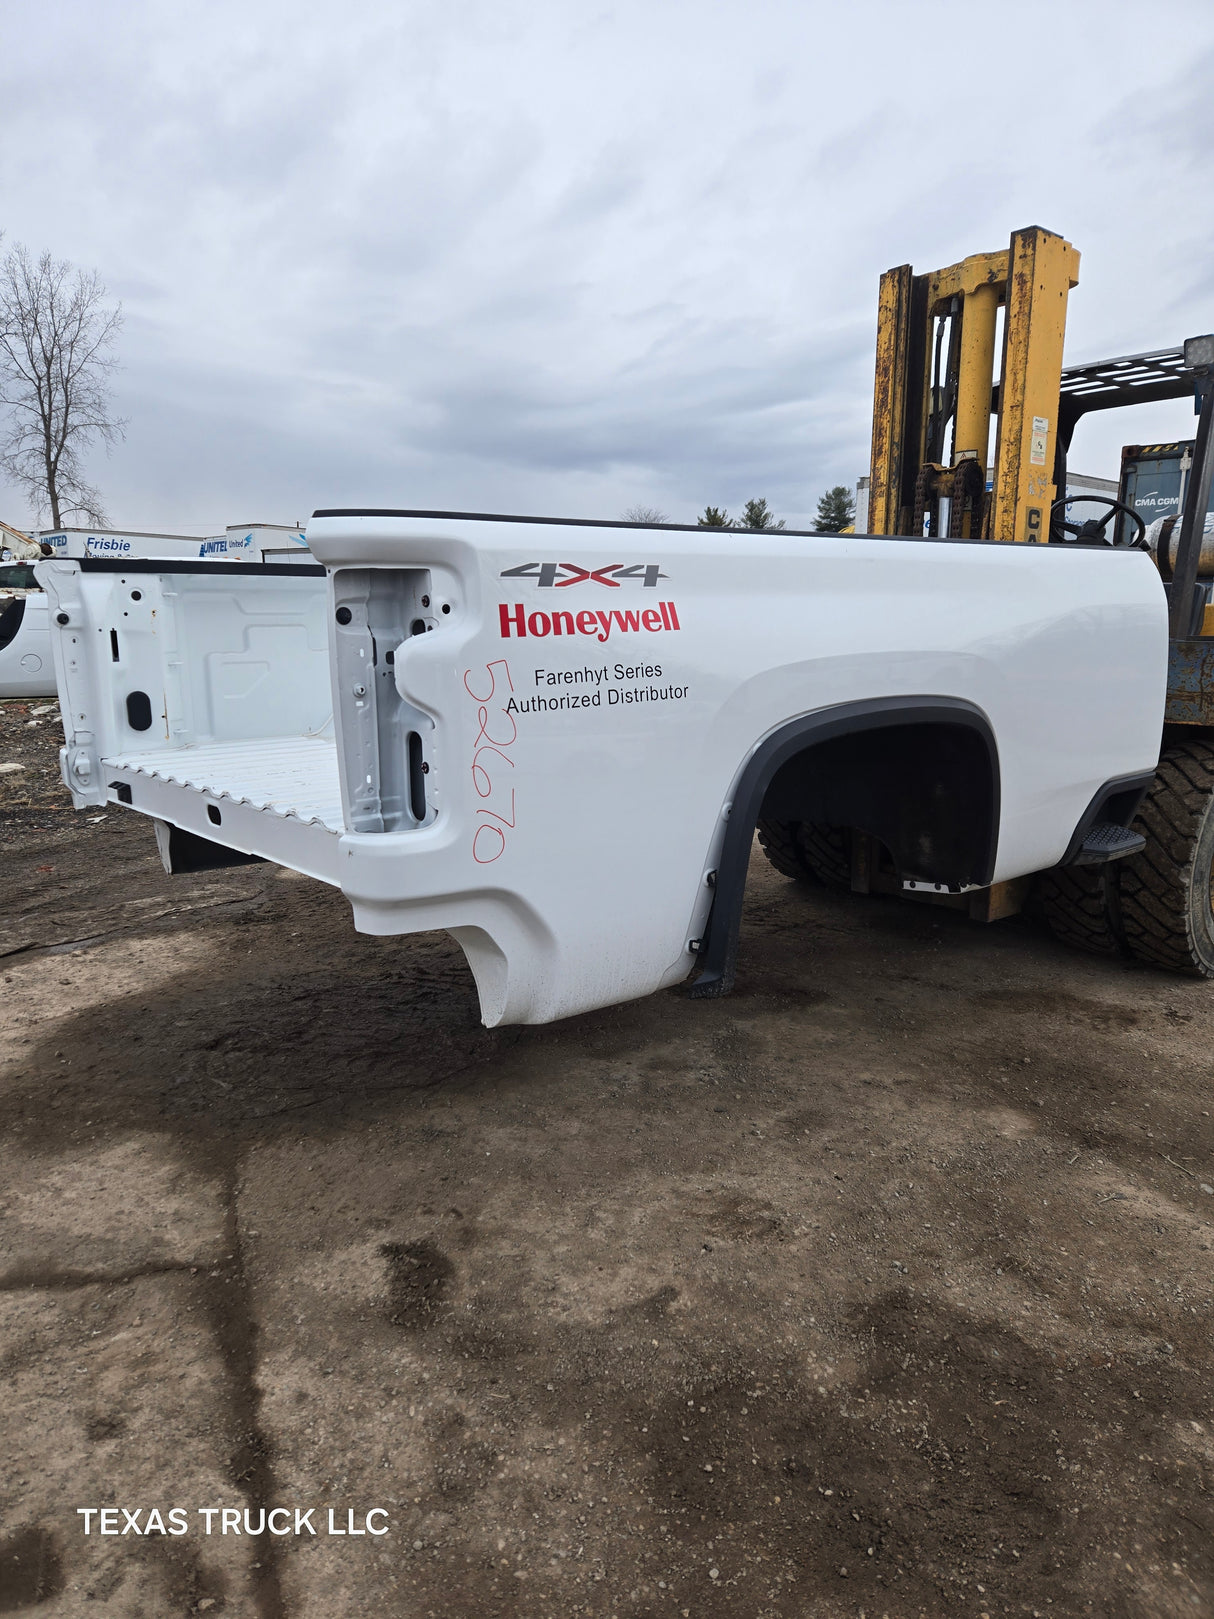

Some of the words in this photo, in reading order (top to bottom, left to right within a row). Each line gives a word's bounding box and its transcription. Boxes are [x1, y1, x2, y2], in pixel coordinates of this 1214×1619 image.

[1135, 499, 1156, 507] CMA
[1157, 497, 1179, 506] CGM
[40, 535, 67, 548] UNITED
[87, 537, 131, 551] Frisbie
[229, 539, 244, 548] United
[498, 601, 681, 643] Honeywell
[534, 667, 609, 688] Farenhyt
[613, 662, 663, 681] Series
[506, 690, 601, 715] Authorized
[607, 683, 689, 706] Distributor
